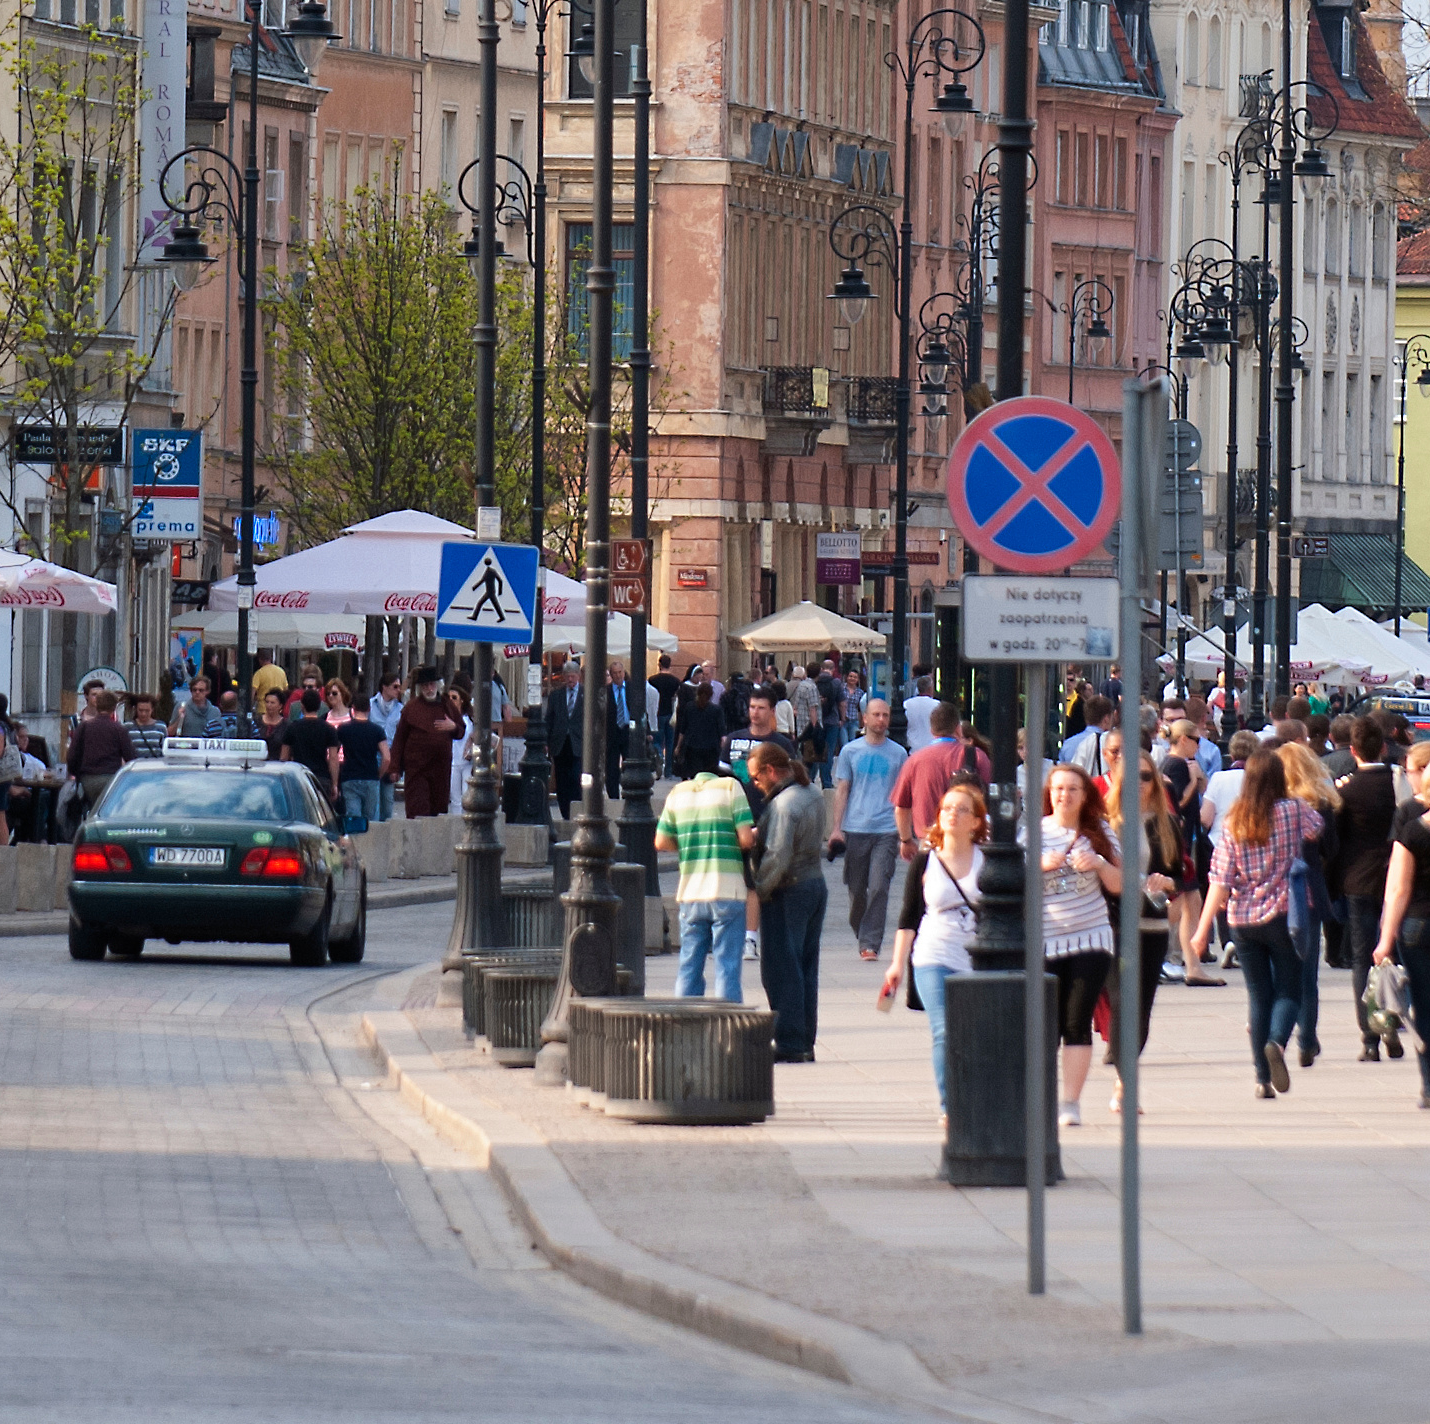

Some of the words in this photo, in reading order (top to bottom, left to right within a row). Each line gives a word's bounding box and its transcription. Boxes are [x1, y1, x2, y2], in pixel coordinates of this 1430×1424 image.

[23, 432, 51, 442] Paula
[142, 438, 191, 452] SKF
[136, 520, 195, 534] prema
[820, 538, 858, 547] BELLOTTO
[614, 585, 633, 604] WC
[1006, 587, 1028, 600] Nie
[1034, 587, 1082, 603] dotyczy
[999, 612, 1089, 627] zaopatrzenia
[989, 640, 998, 649] w
[1003, 637, 1039, 653] godz.
[90, 671, 117, 681] SHOP
[202, 739, 227, 751] TAXI
[156, 848, 176, 862] WD
[180, 848, 223, 863] 7700A
